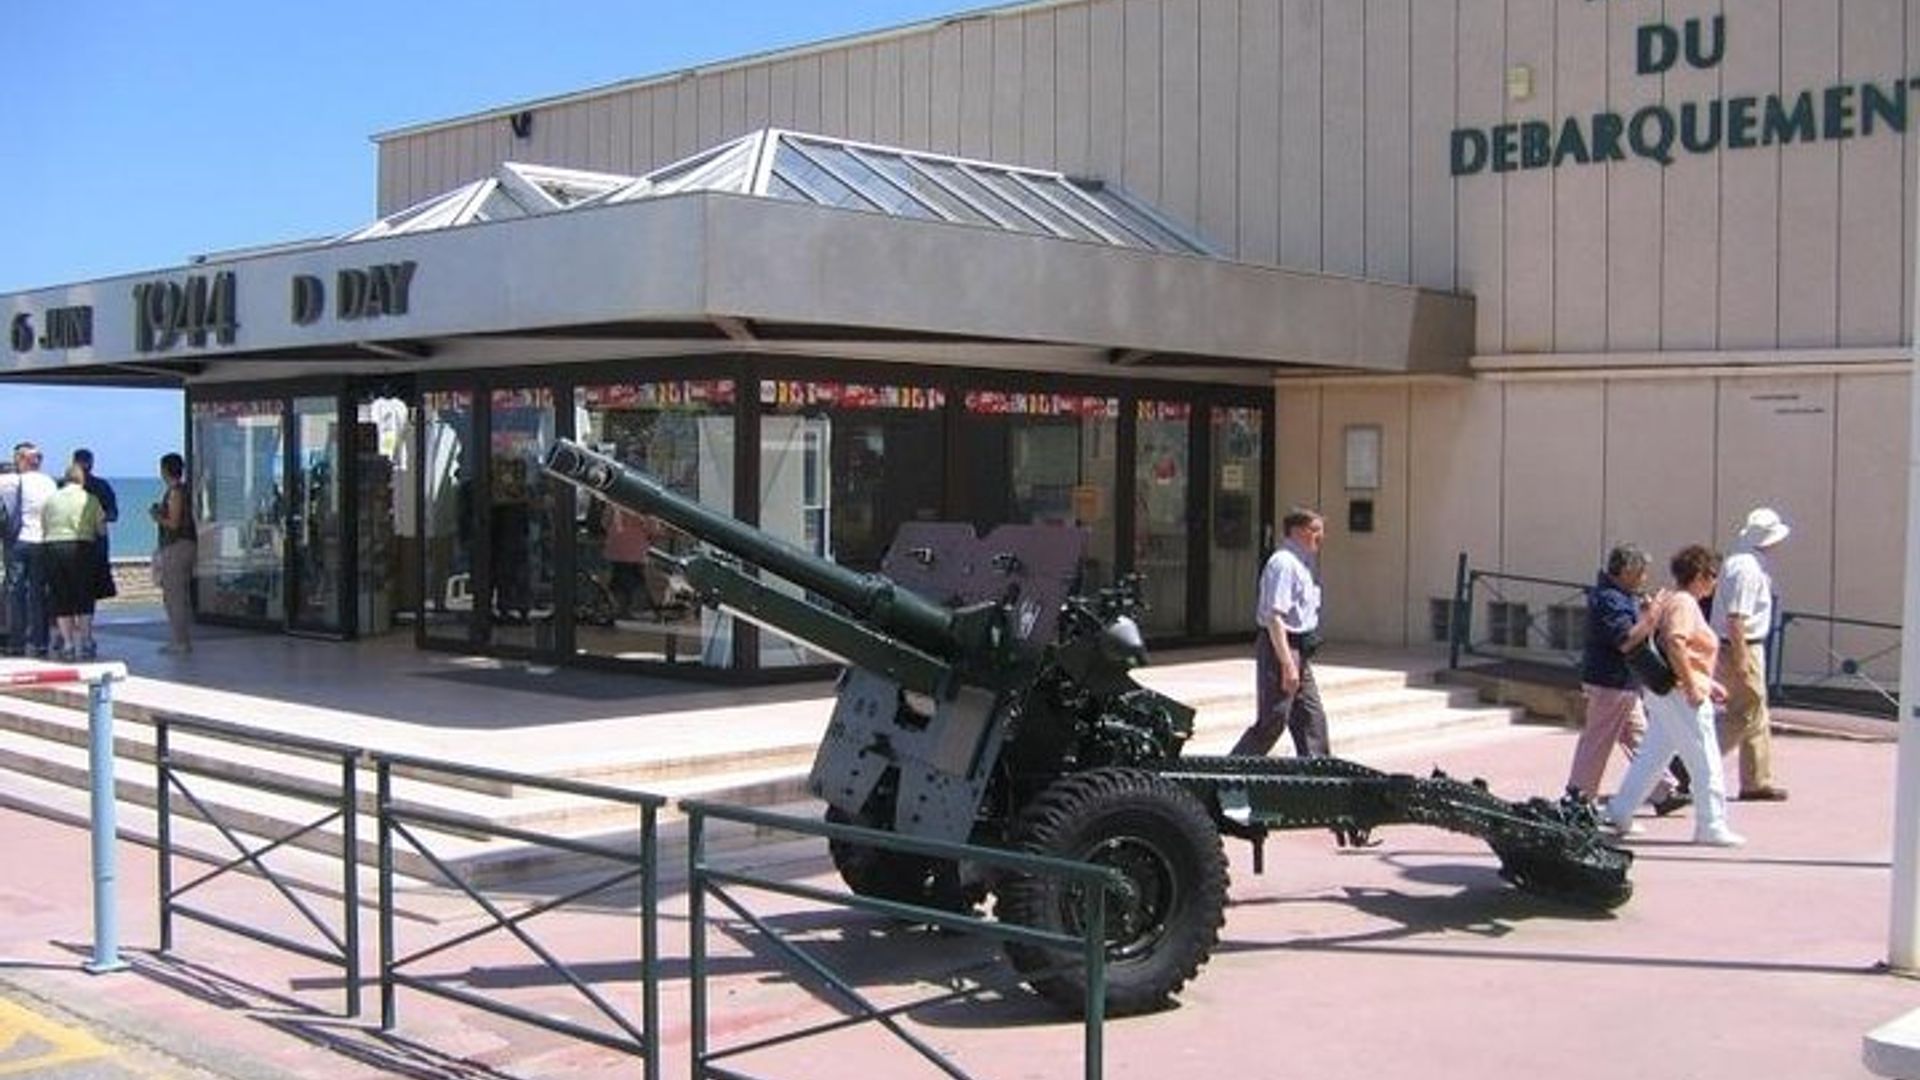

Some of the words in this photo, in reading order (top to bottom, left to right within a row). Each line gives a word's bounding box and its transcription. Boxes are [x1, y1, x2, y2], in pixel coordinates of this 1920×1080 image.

[1636, 15, 1725, 76] DU
[11, 311, 35, 353] 6
[38, 304, 94, 350] JUIN
[131, 270, 240, 352] 1944
[291, 274, 324, 326] D
[336, 260, 417, 320] DAY
